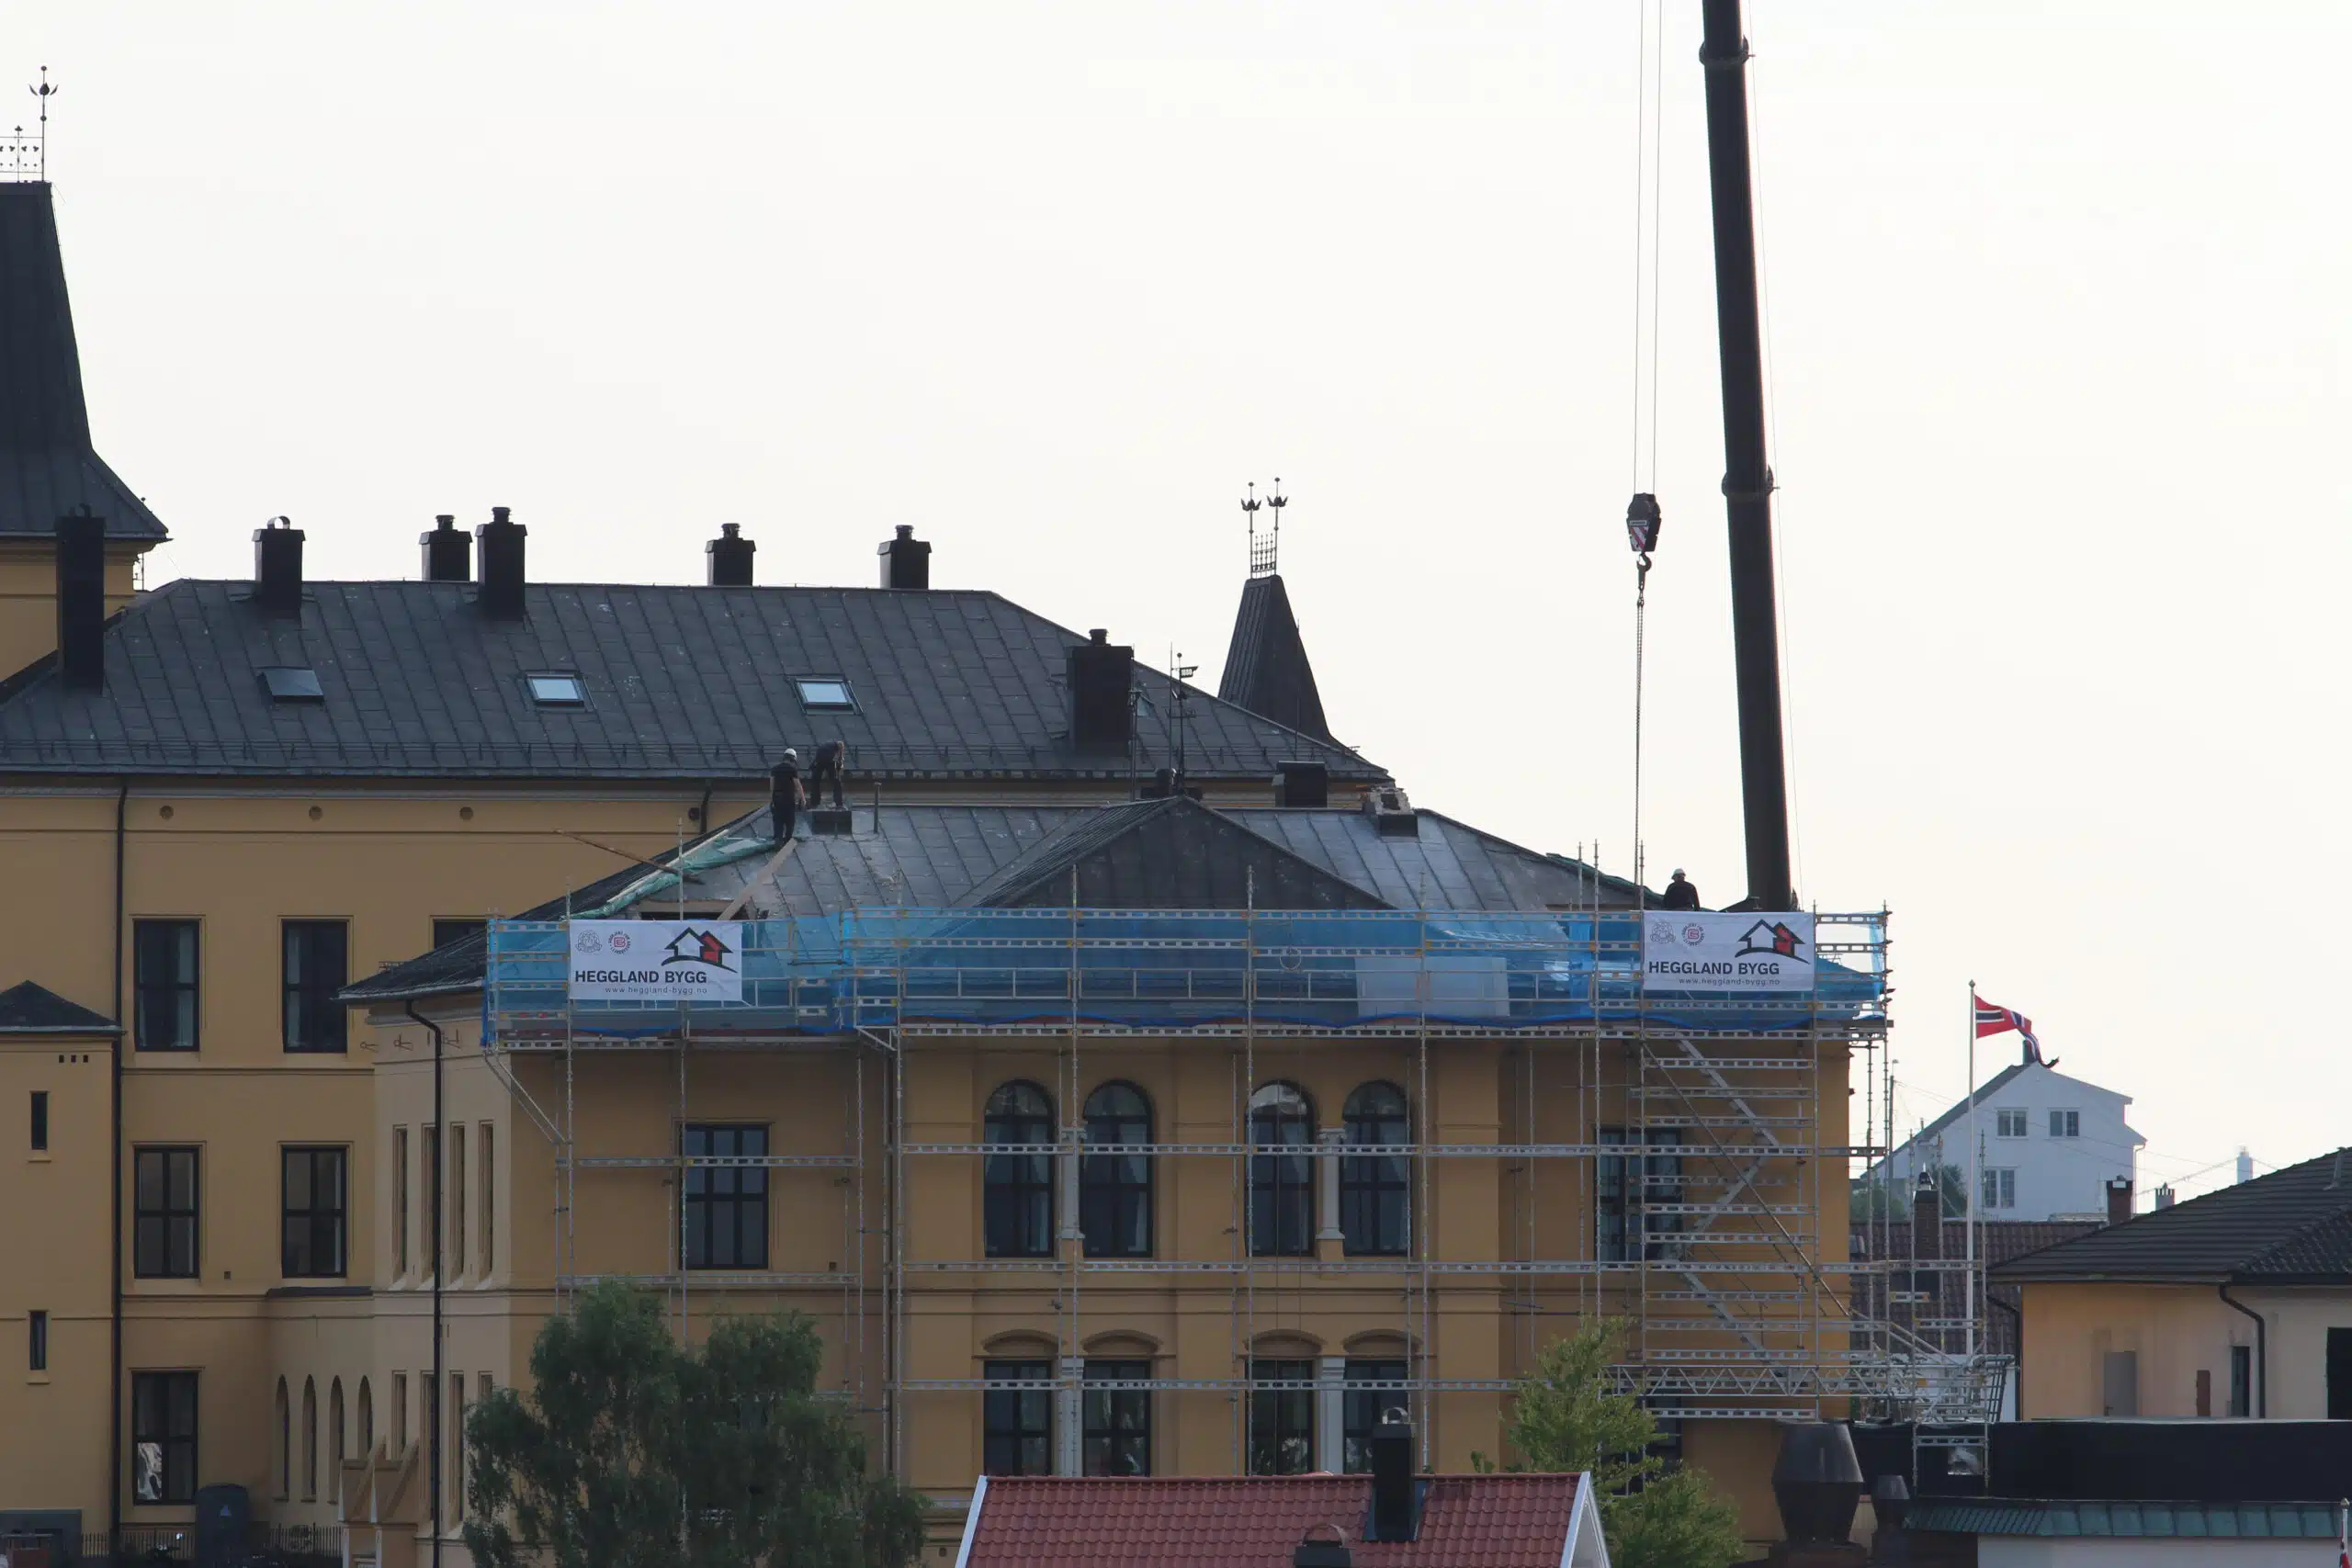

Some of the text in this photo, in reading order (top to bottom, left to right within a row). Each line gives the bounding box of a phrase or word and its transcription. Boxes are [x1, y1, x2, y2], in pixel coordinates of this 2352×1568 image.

[1648, 961, 1780, 975] HEGGLAND BYGG
[574, 970, 707, 984] HEGGLAND BYGG
[1679, 977, 1781, 987] www.heggland-bygg.no
[605, 987, 707, 996] www.heggland-bygg.no
